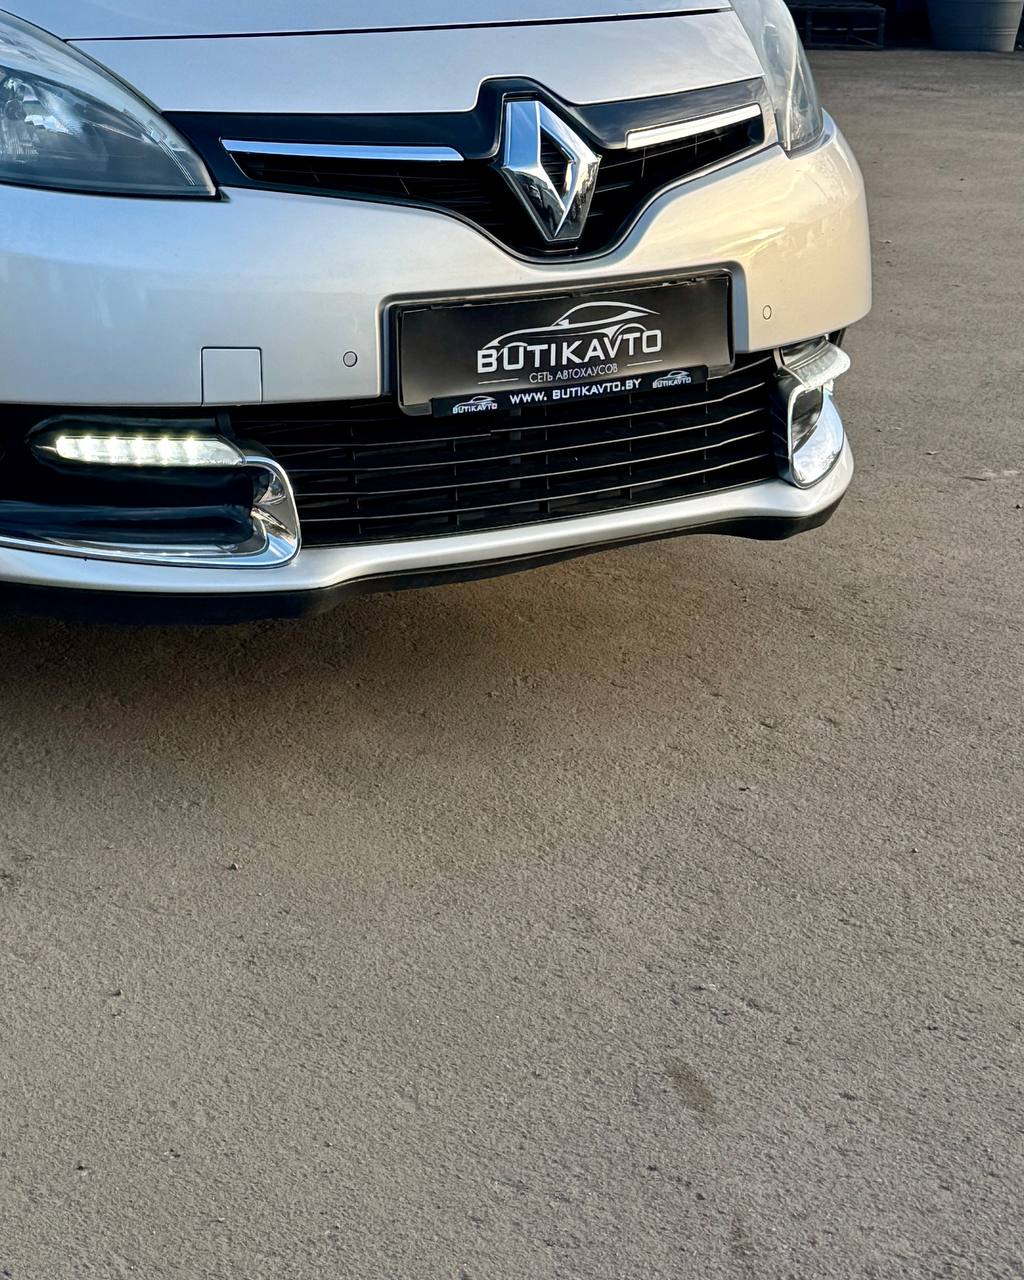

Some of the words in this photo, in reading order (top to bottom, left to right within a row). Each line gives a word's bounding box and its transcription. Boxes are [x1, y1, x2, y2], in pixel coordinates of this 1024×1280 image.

[477, 329, 662, 374] BUTIKAVTO
[529, 371, 554, 384] СЕТЬ
[556, 363, 619, 382] АВТОХАУСОВ
[652, 376, 692, 389] BUTIKAVTO
[509, 391, 548, 405] WWW.
[552, 378, 642, 401] BUTIKAVTO.BY
[452, 402, 498, 415] BUTIKAVTO
